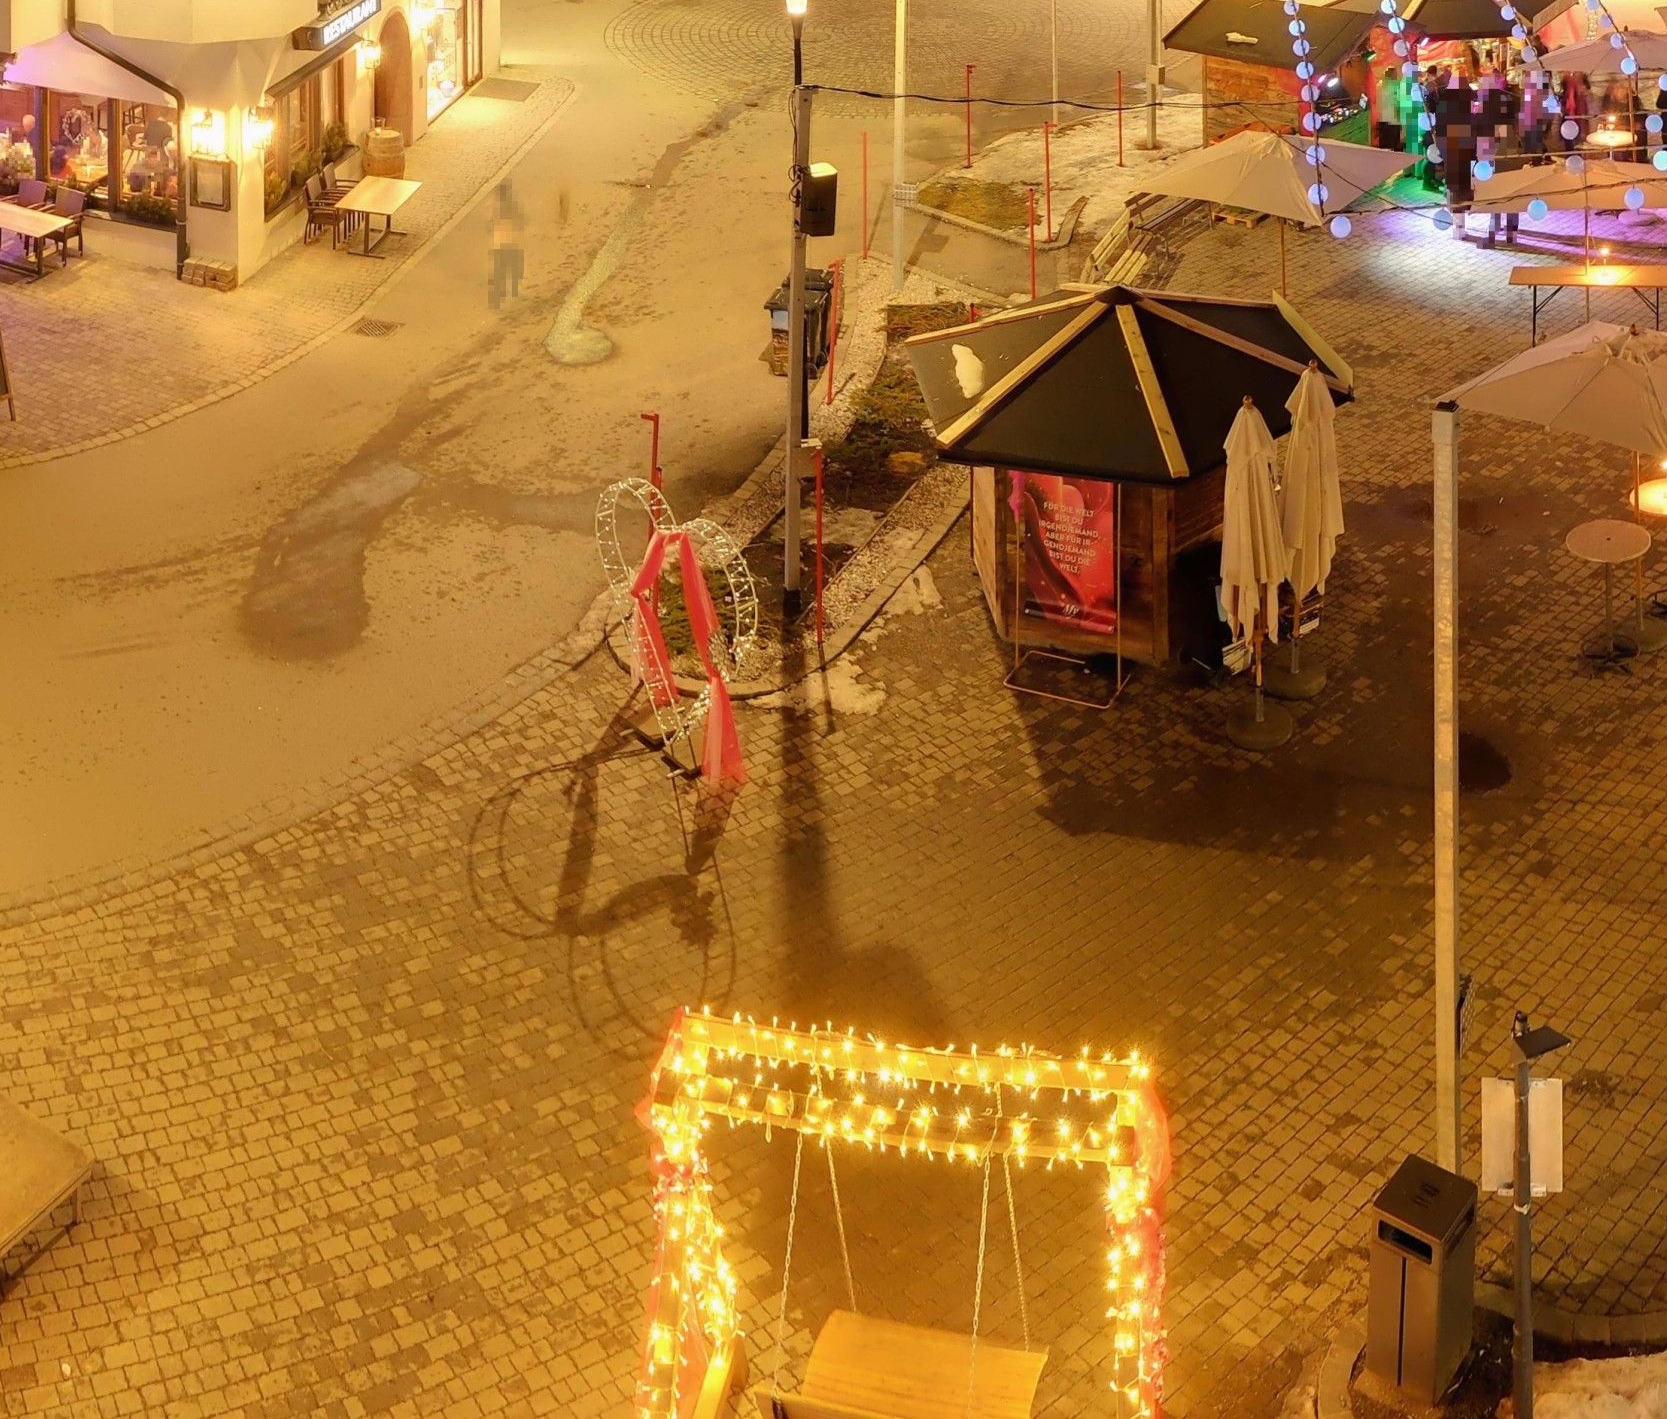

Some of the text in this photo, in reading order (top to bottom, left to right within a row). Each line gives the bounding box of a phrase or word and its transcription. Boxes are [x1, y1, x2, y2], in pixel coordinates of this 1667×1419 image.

[1043, 501, 1095, 518] FÜR DIE WELT
[1055, 514, 1083, 525] BIST DU
[1045, 531, 1065, 541] ABER
[1066, 534, 1081, 545] FÜR
[1049, 551, 1091, 566] BIST DU DIE
